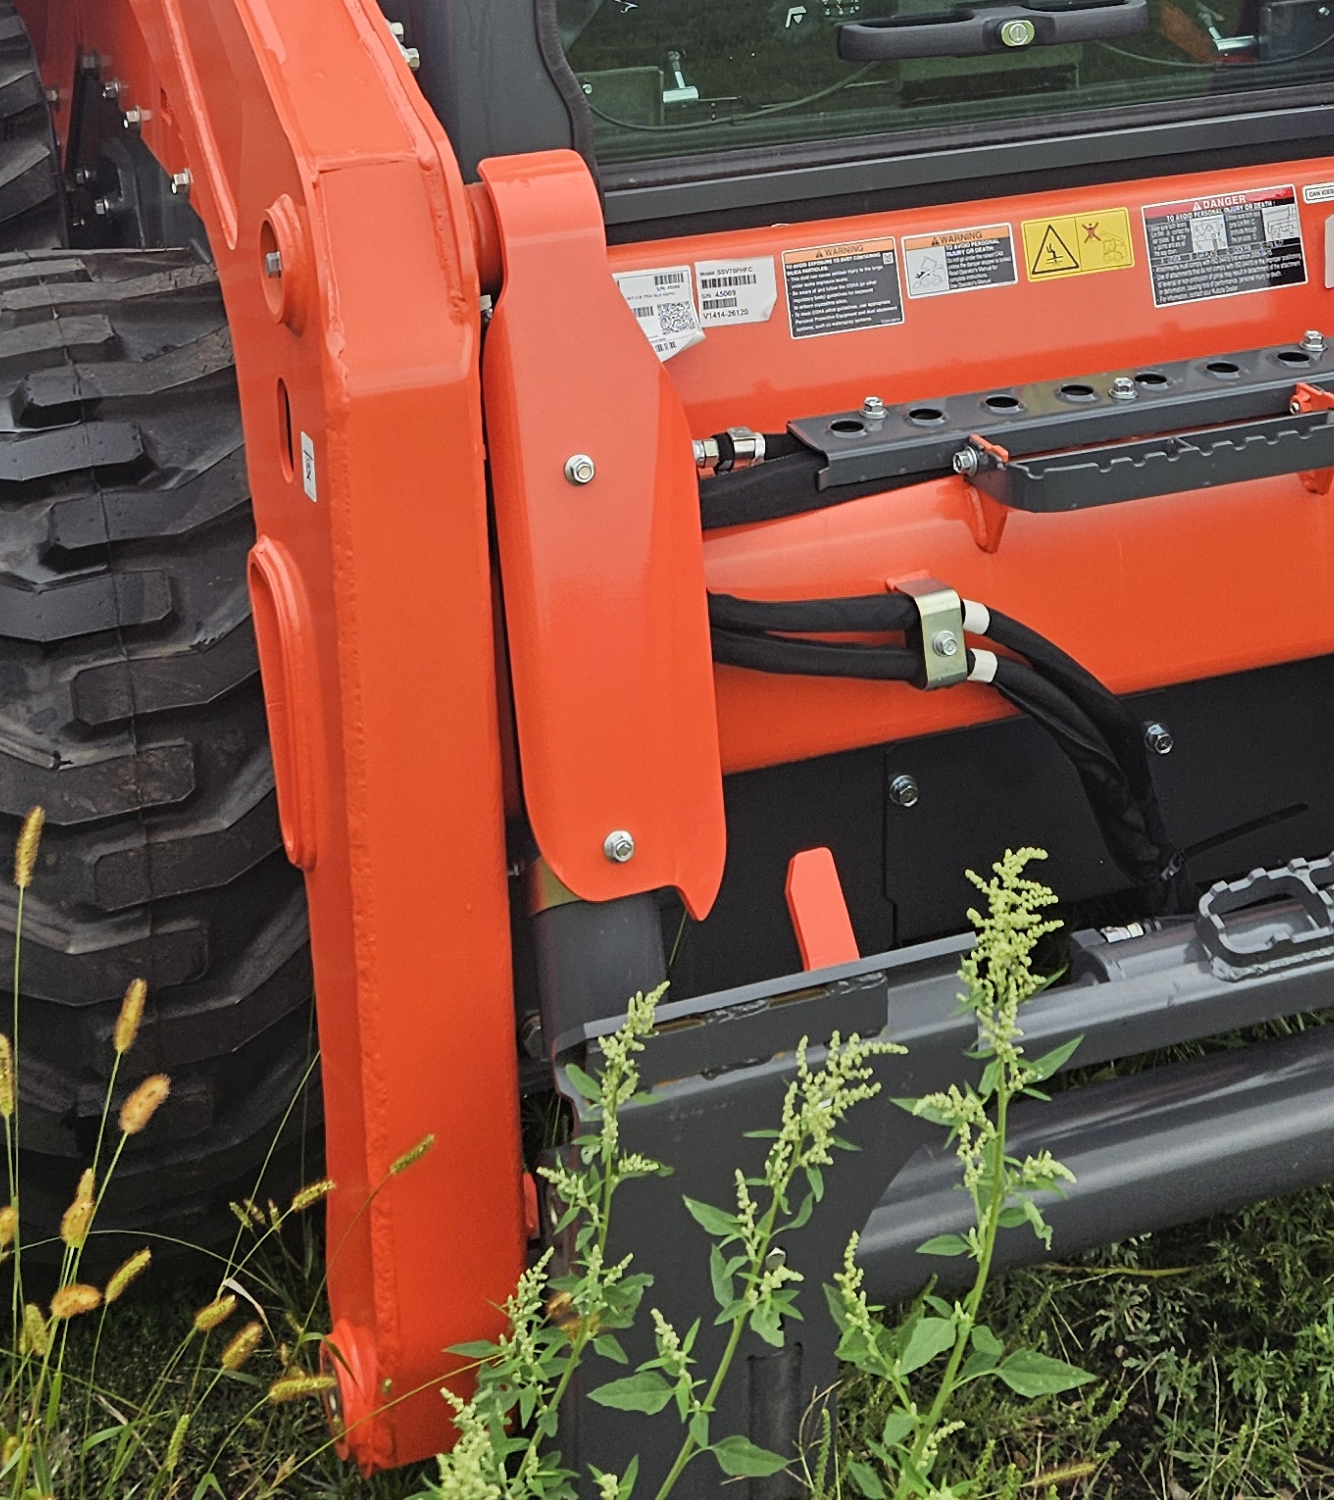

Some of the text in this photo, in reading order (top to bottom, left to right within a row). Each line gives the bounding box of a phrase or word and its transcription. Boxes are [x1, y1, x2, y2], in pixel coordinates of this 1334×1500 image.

[1203, 195, 1246, 209] DANGER
[939, 231, 983, 244] WARNING
[825, 244, 863, 256] WARNING
